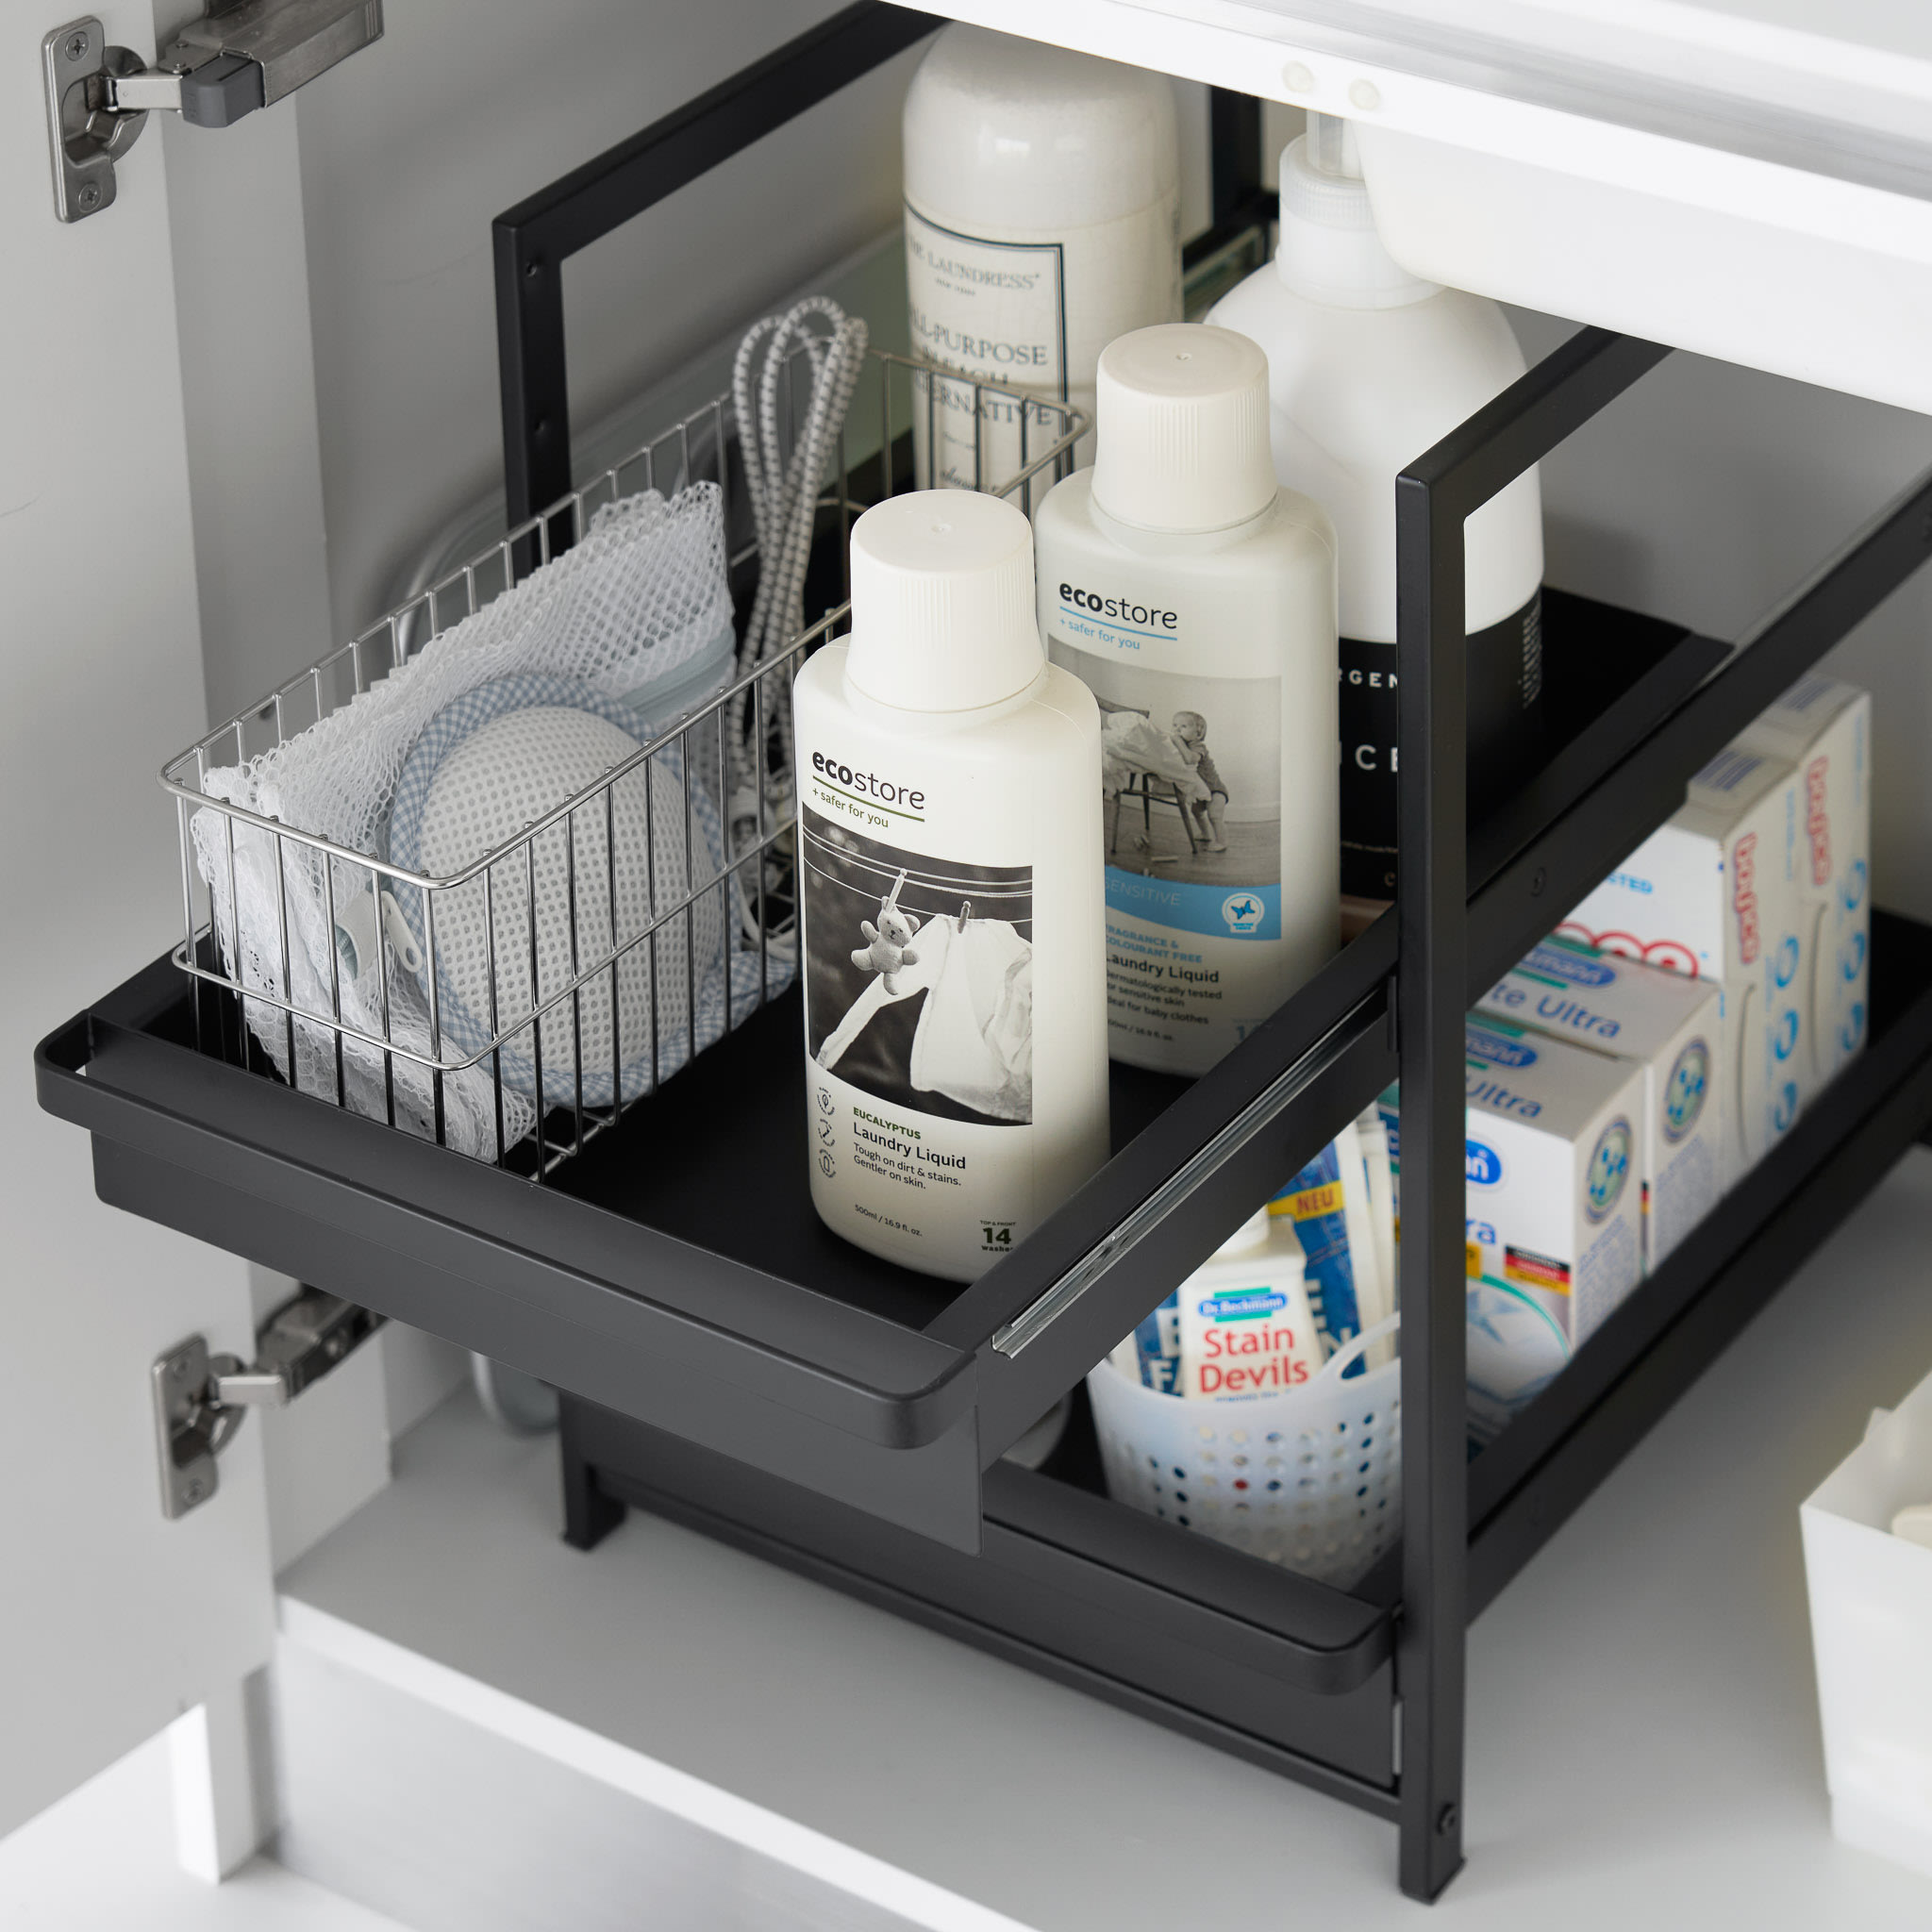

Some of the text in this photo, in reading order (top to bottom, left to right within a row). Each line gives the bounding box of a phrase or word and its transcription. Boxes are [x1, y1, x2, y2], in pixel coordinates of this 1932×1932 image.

[1059, 583, 1177, 629] ecostore
[1068, 621, 1094, 637] safer
[1098, 629, 1115, 643] for
[1118, 637, 1141, 649] you
[812, 751, 924, 809] ecostore
[821, 791, 846, 810] safer
[848, 803, 865, 819] for
[867, 813, 889, 827] you
[1106, 924, 1168, 947] RAGRANCE
[1172, 951, 1203, 963] FREE
[1107, 969, 1224, 1000] ermatologically tested
[1169, 965, 1220, 983] Liquid
[1127, 1001, 1141, 1012] for
[1143, 1006, 1169, 1021] baby
[1171, 1011, 1210, 1025] clothes
[1164, 996, 1186, 1008] skin
[1536, 994, 1621, 1039] Ultra
[853, 1107, 922, 1140] EUCALYPTUS
[853, 1122, 911, 1158] Laundry
[916, 1146, 966, 1170] Liquid
[853, 1141, 961, 1186] Tough on dirt & stains.
[853, 1155, 887, 1175] Gentler
[889, 1171, 902, 1181] on
[903, 1175, 926, 1190] skin.
[855, 1204, 877, 1220] 500ml
[885, 1218, 901, 1229] 16.9
[1296, 1189, 1335, 1214] NEU
[983, 1226, 1012, 1244] 14
[1204, 1323, 1295, 1358] Stain
[1199, 1357, 1309, 1393] Devils
